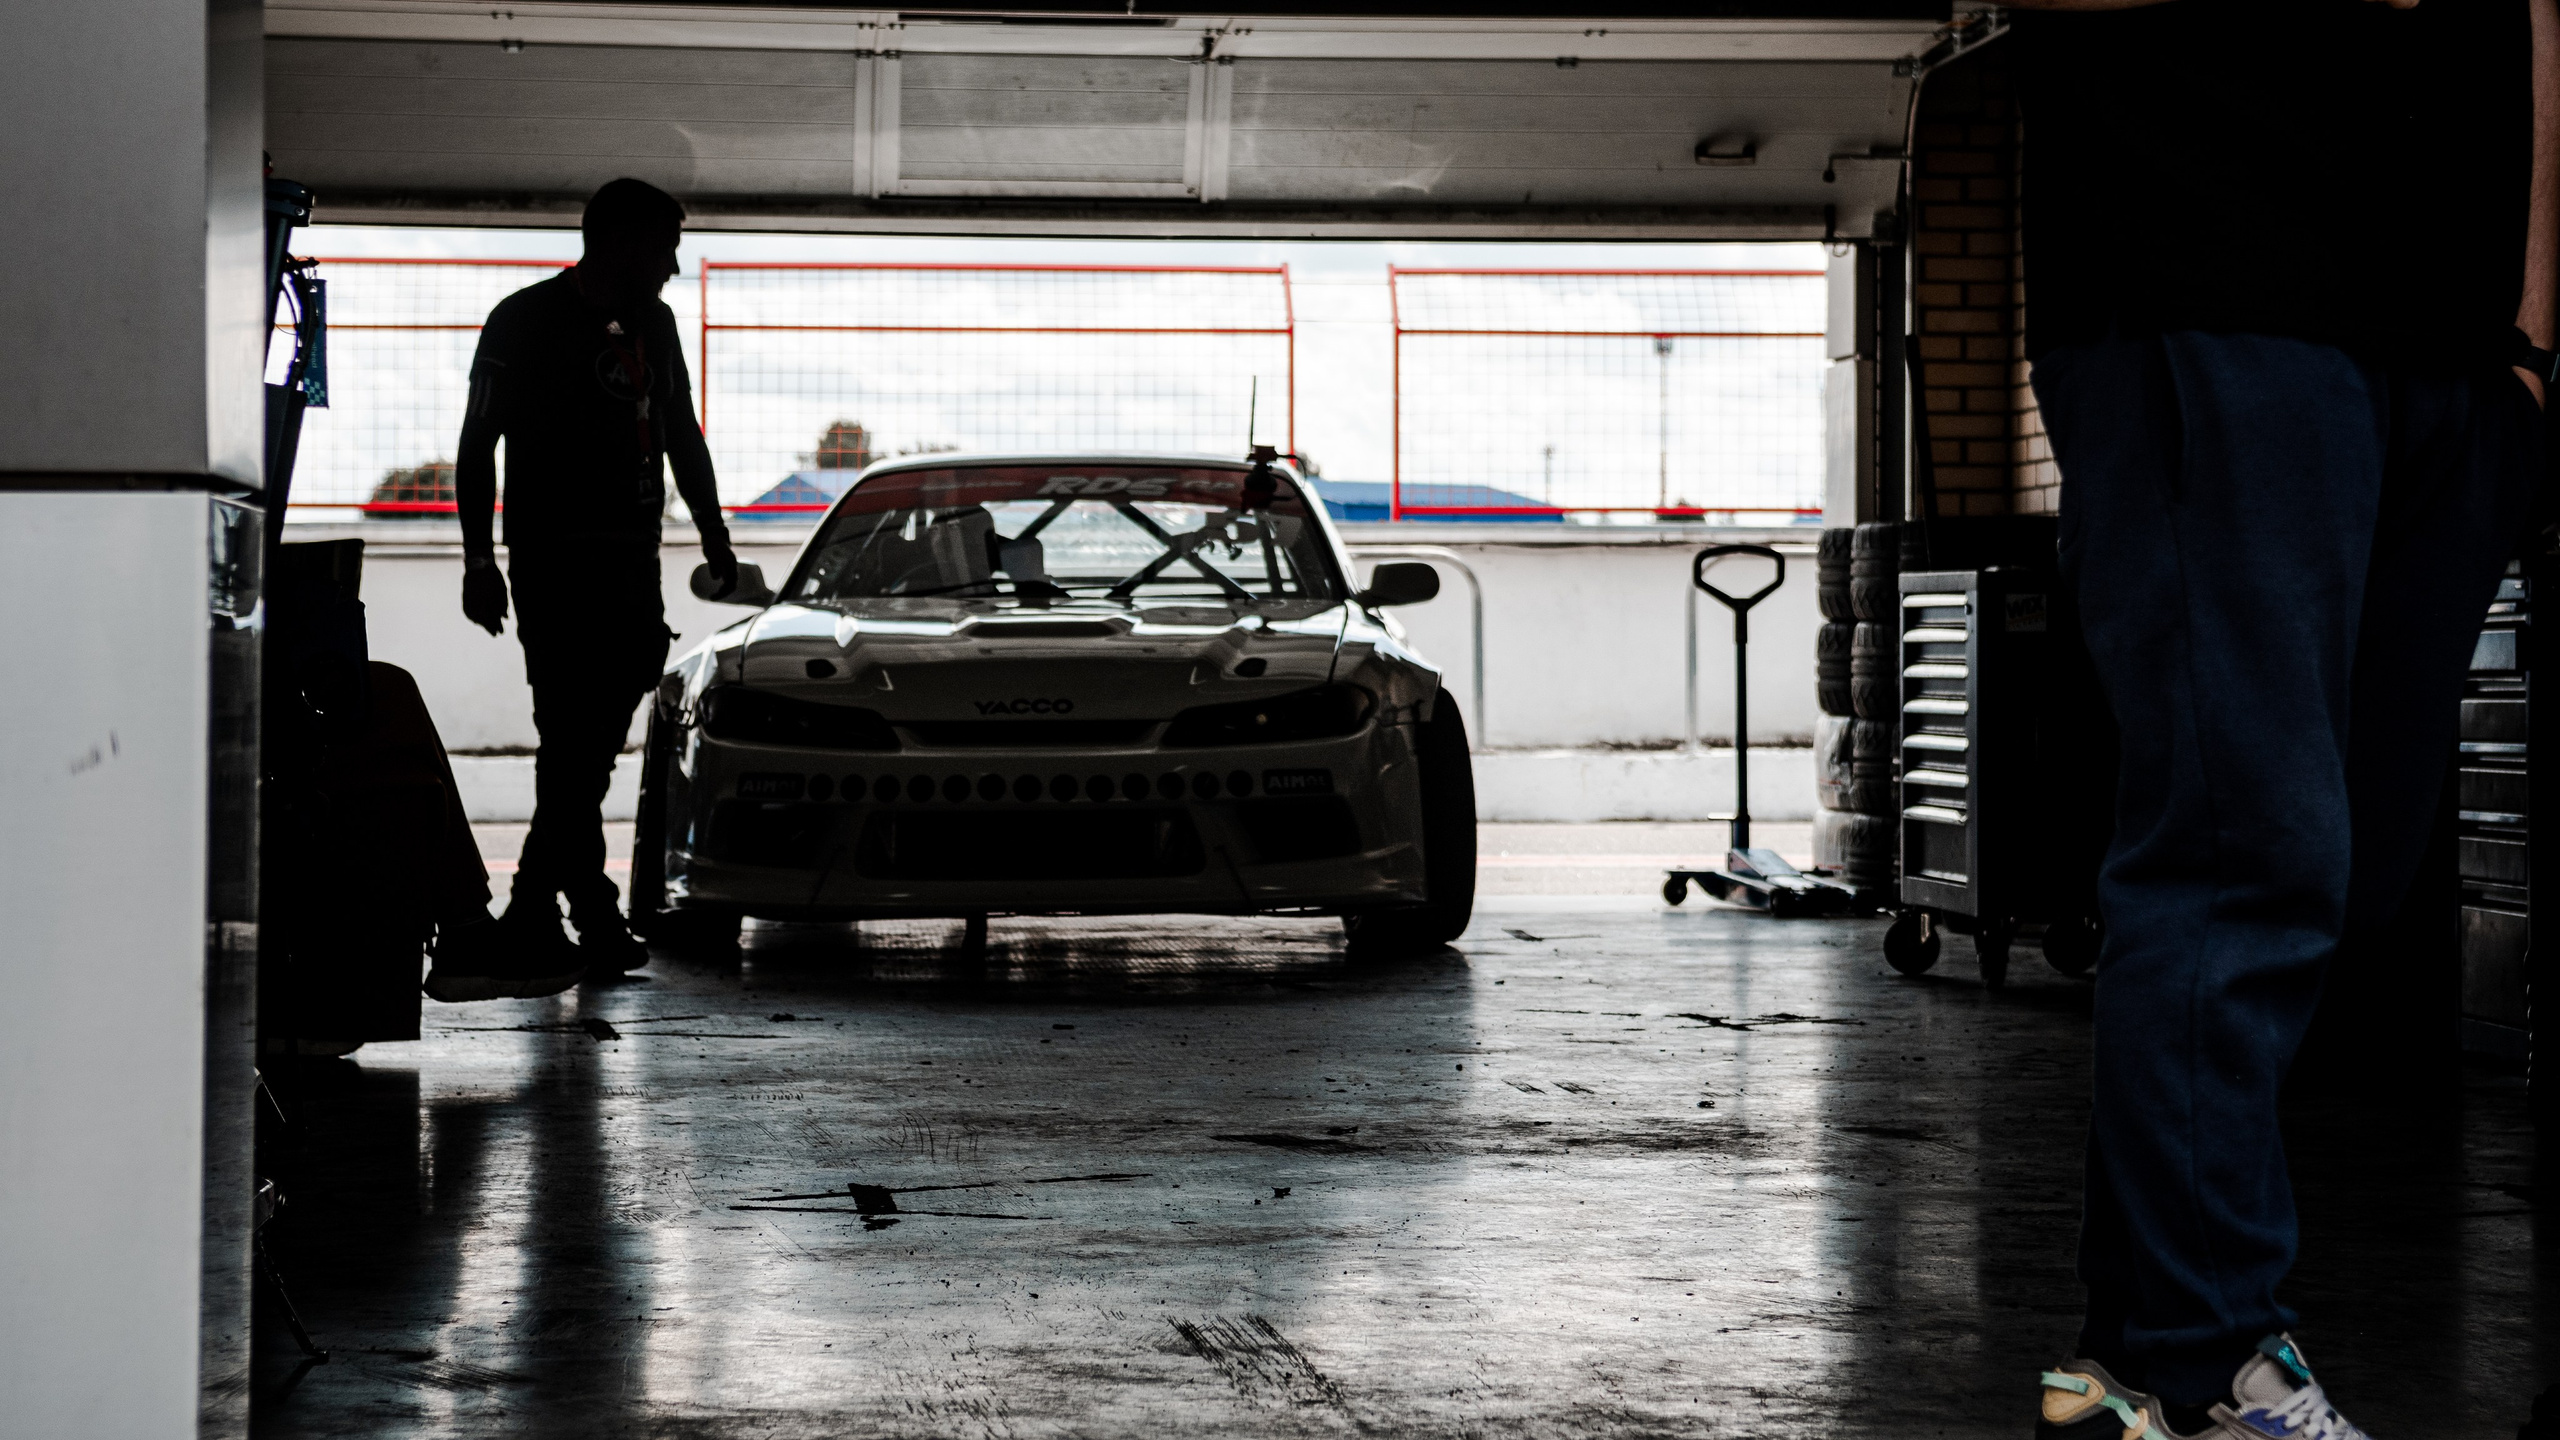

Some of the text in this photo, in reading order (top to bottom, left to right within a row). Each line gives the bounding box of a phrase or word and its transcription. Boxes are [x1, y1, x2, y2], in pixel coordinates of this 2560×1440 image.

[1036, 475, 1178, 497] RDS
[2006, 597, 2044, 617] WIX
[974, 699, 1073, 714] YACCO
